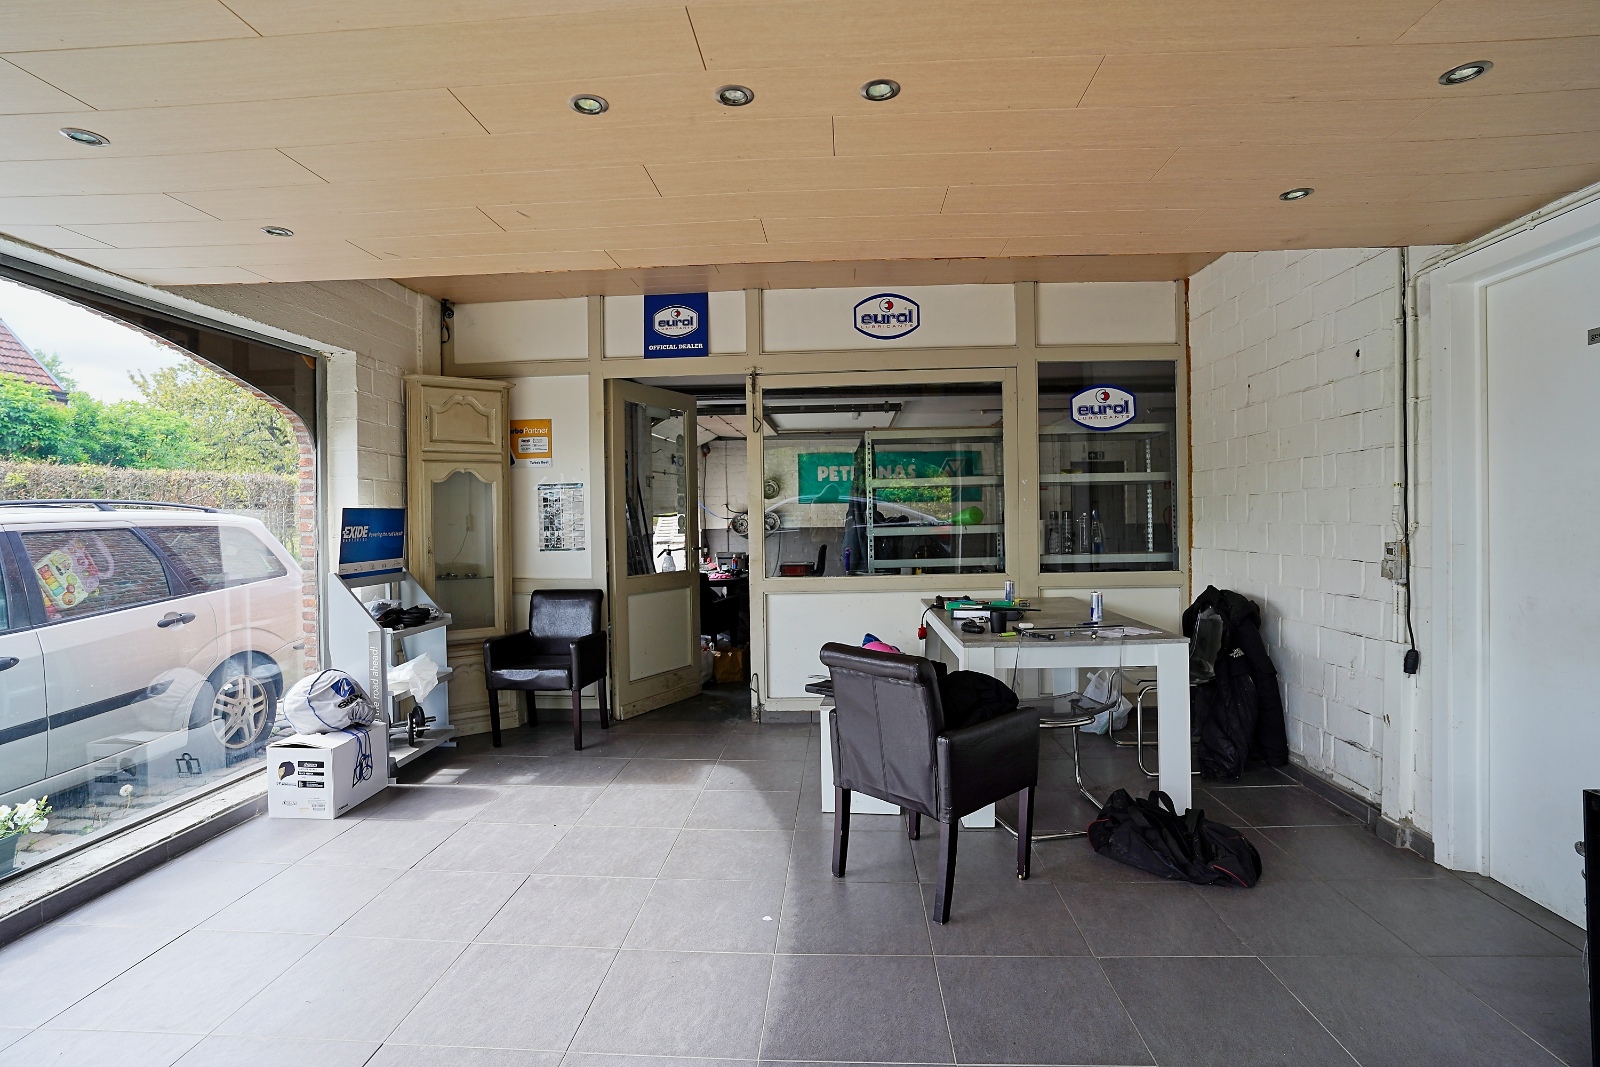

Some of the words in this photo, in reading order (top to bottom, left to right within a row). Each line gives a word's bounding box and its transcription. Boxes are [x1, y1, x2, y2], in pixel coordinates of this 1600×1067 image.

[658, 316, 693, 327] eurol
[861, 308, 913, 324] eurol
[1590, 333, 1600, 342] ge
[1077, 400, 1130, 416] eurol
[817, 464, 917, 482] PETNAS
[343, 526, 369, 538] EXIDE
[369, 646, 379, 676] ahead!
[370, 678, 380, 699] road
